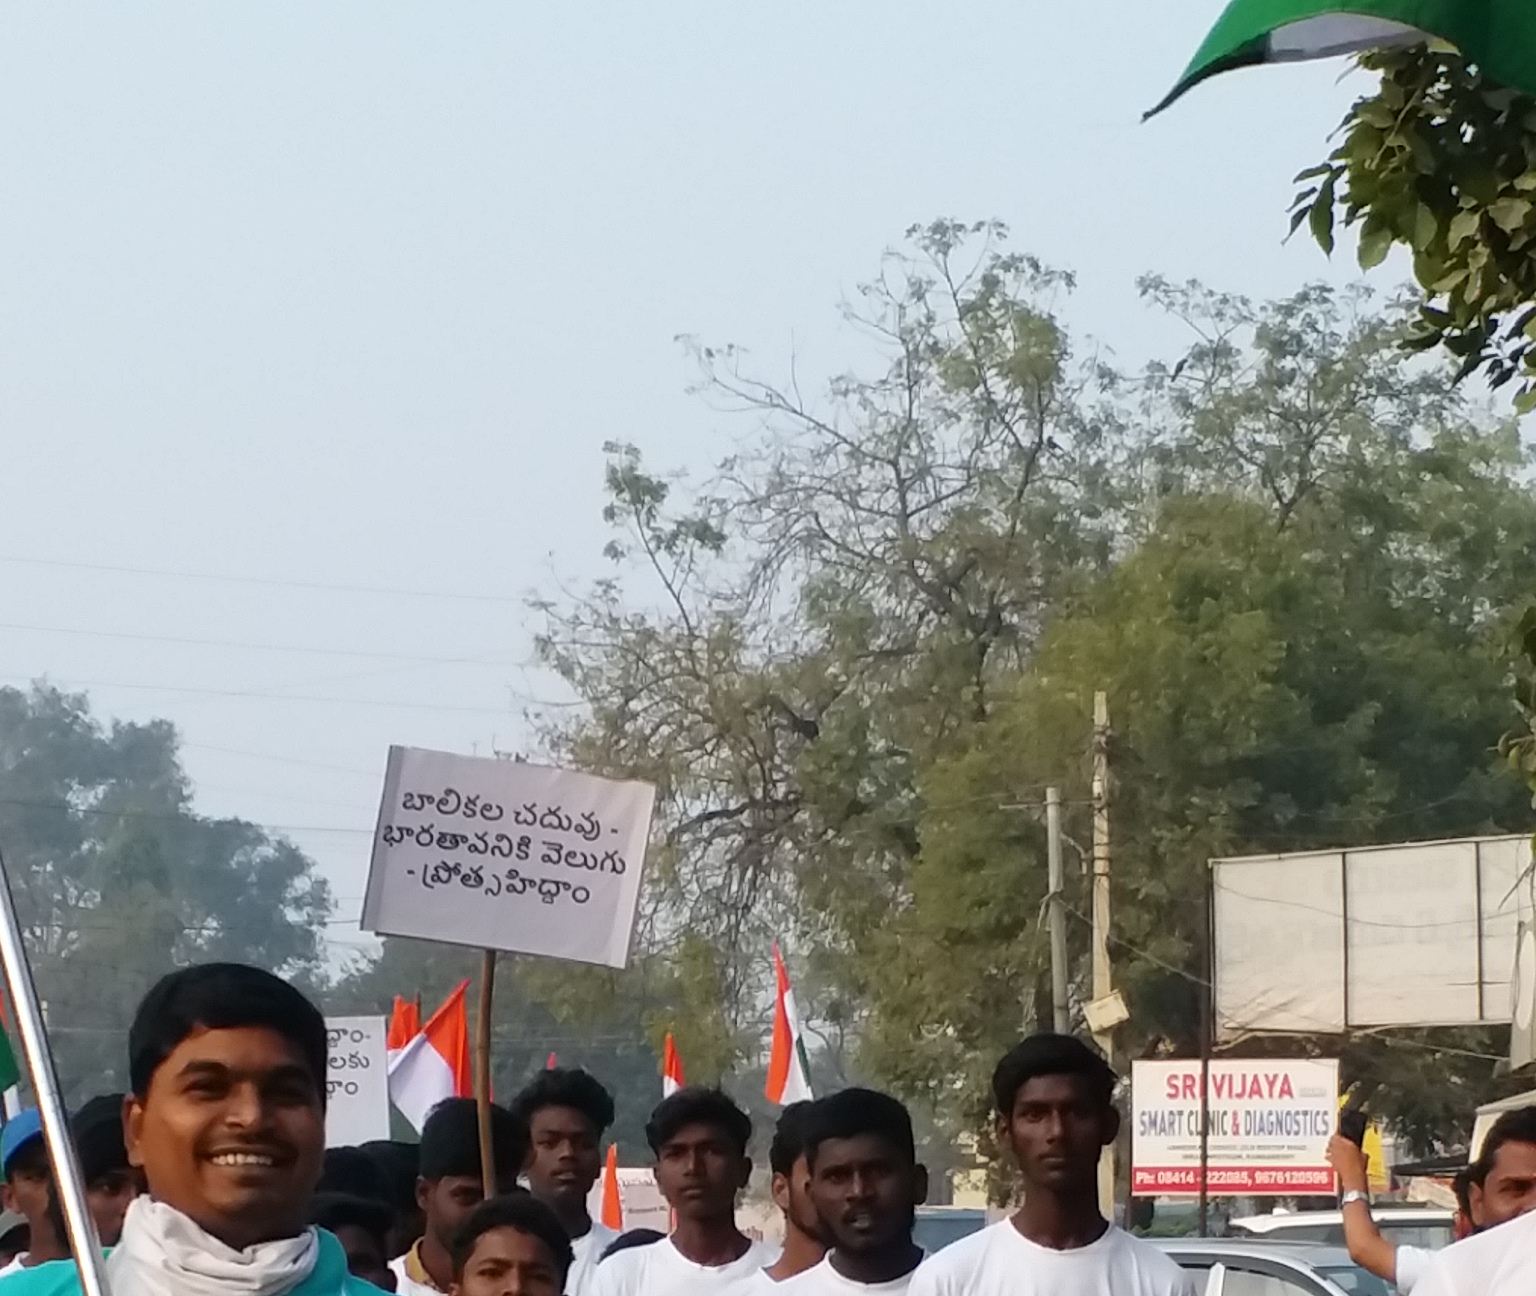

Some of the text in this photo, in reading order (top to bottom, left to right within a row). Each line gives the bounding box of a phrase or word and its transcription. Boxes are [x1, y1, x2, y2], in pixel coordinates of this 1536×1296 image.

[402, 787, 504, 822] బాలికల
[514, 803, 601, 842] చదువు
[541, 841, 627, 875] వెలుగు
[1211, 1073, 1294, 1099] VIJAYA
[1139, 1110, 1330, 1136] SMART CLNIC & DIAGNOSTICS
